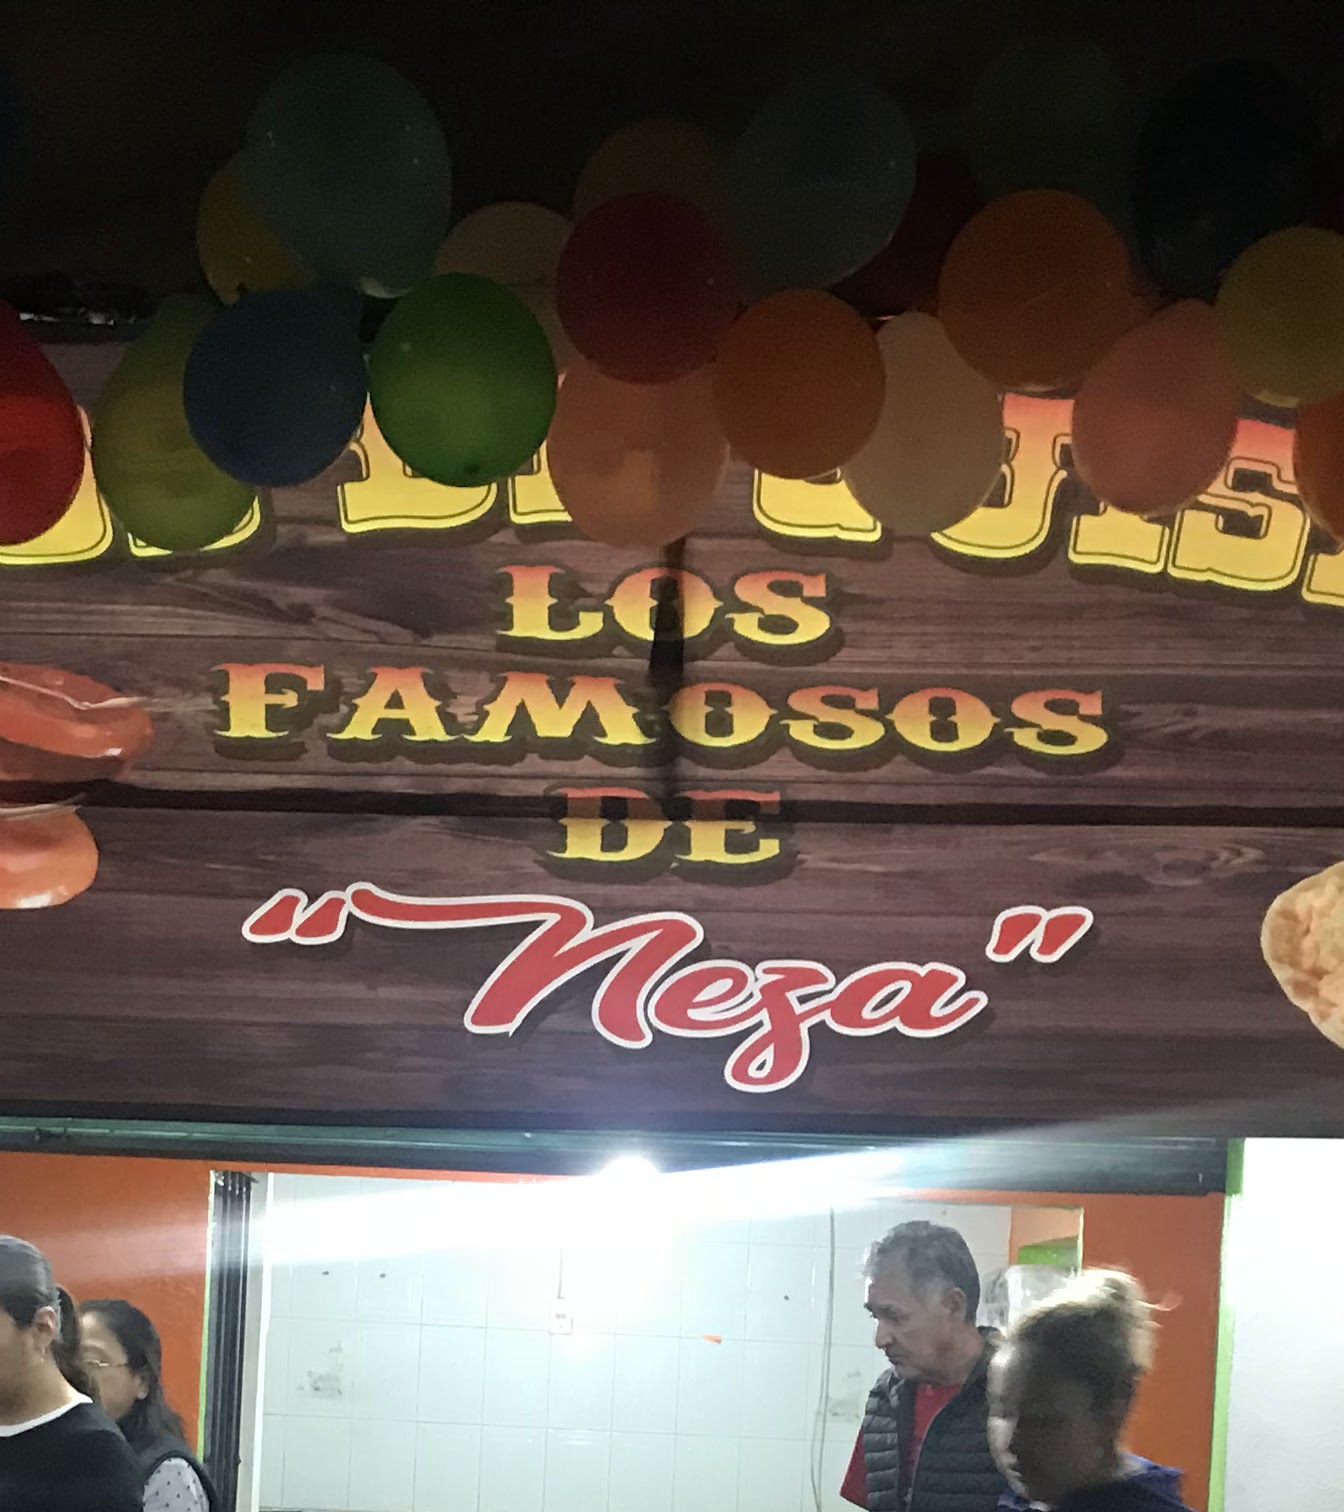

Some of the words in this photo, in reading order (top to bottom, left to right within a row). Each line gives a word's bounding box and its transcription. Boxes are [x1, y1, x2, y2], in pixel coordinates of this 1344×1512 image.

[497, 564, 831, 647] LOS
[213, 661, 1110, 757] FAMOSOS
[544, 785, 783, 867] DE
